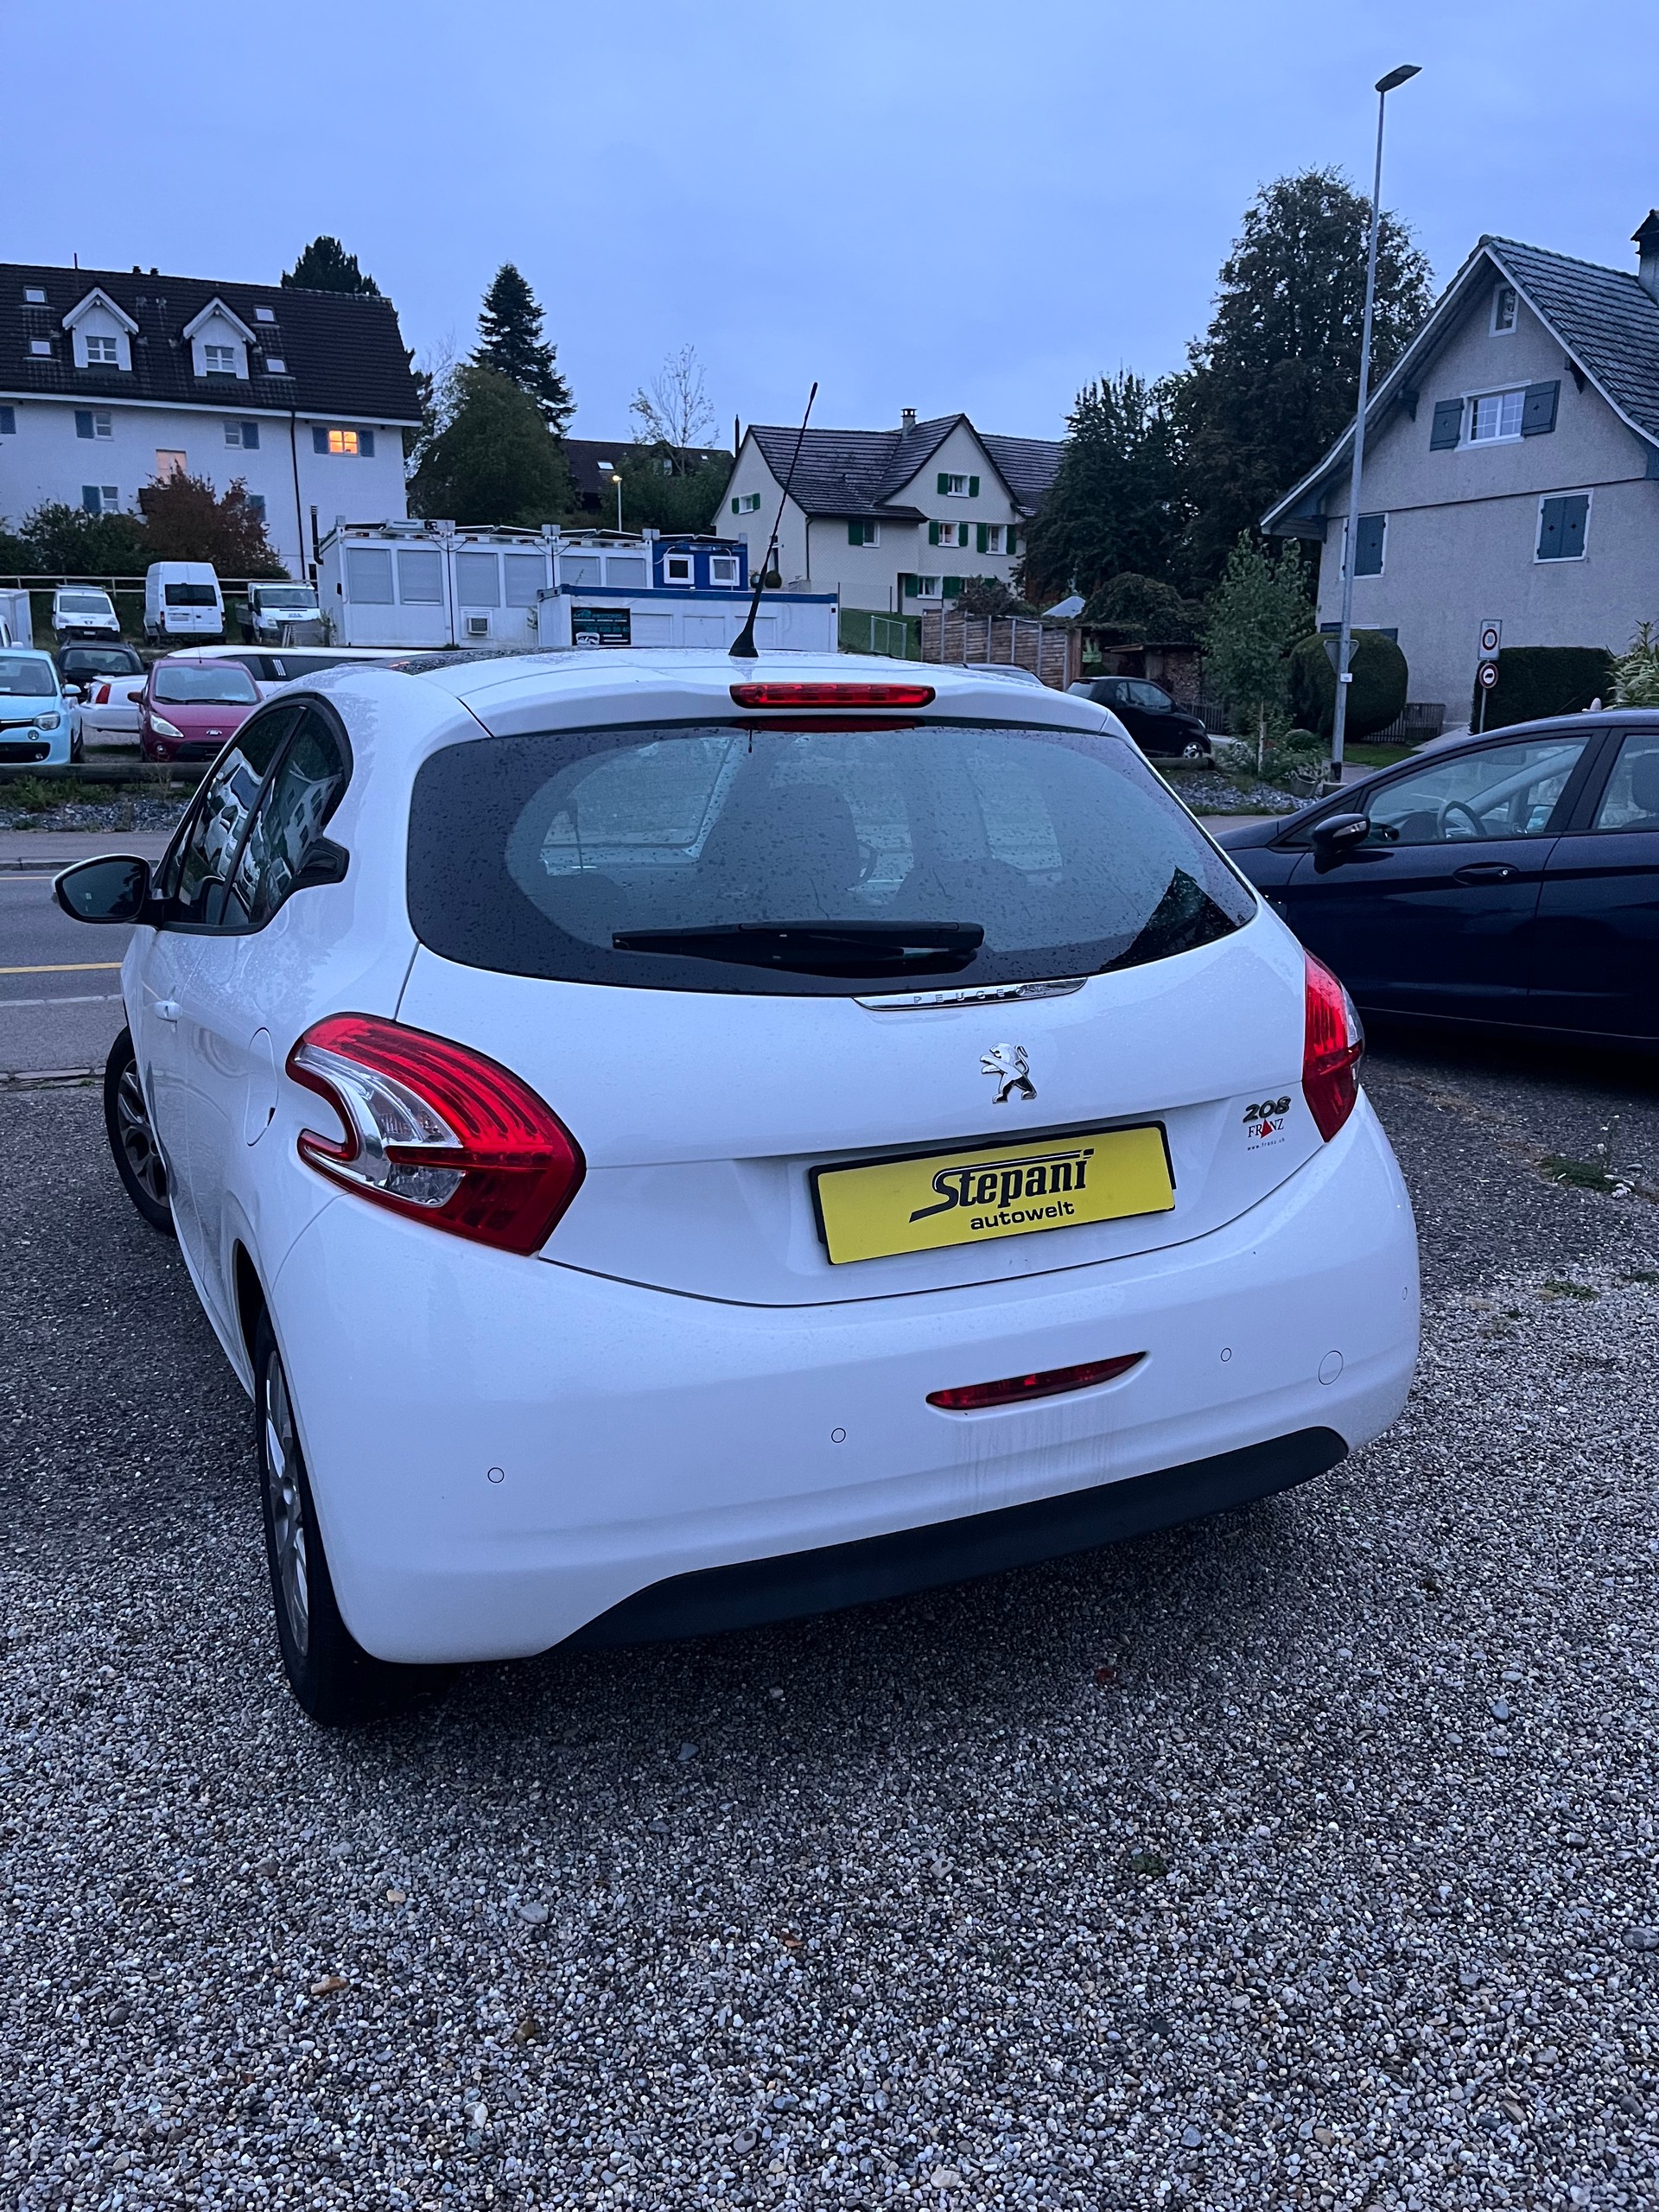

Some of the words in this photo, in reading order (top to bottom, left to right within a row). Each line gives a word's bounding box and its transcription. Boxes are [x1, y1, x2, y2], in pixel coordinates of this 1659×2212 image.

[1243, 1096, 1291, 1123] 208
[909, 1148, 1094, 1224] Stepani
[970, 1201, 1075, 1230] autowelt
